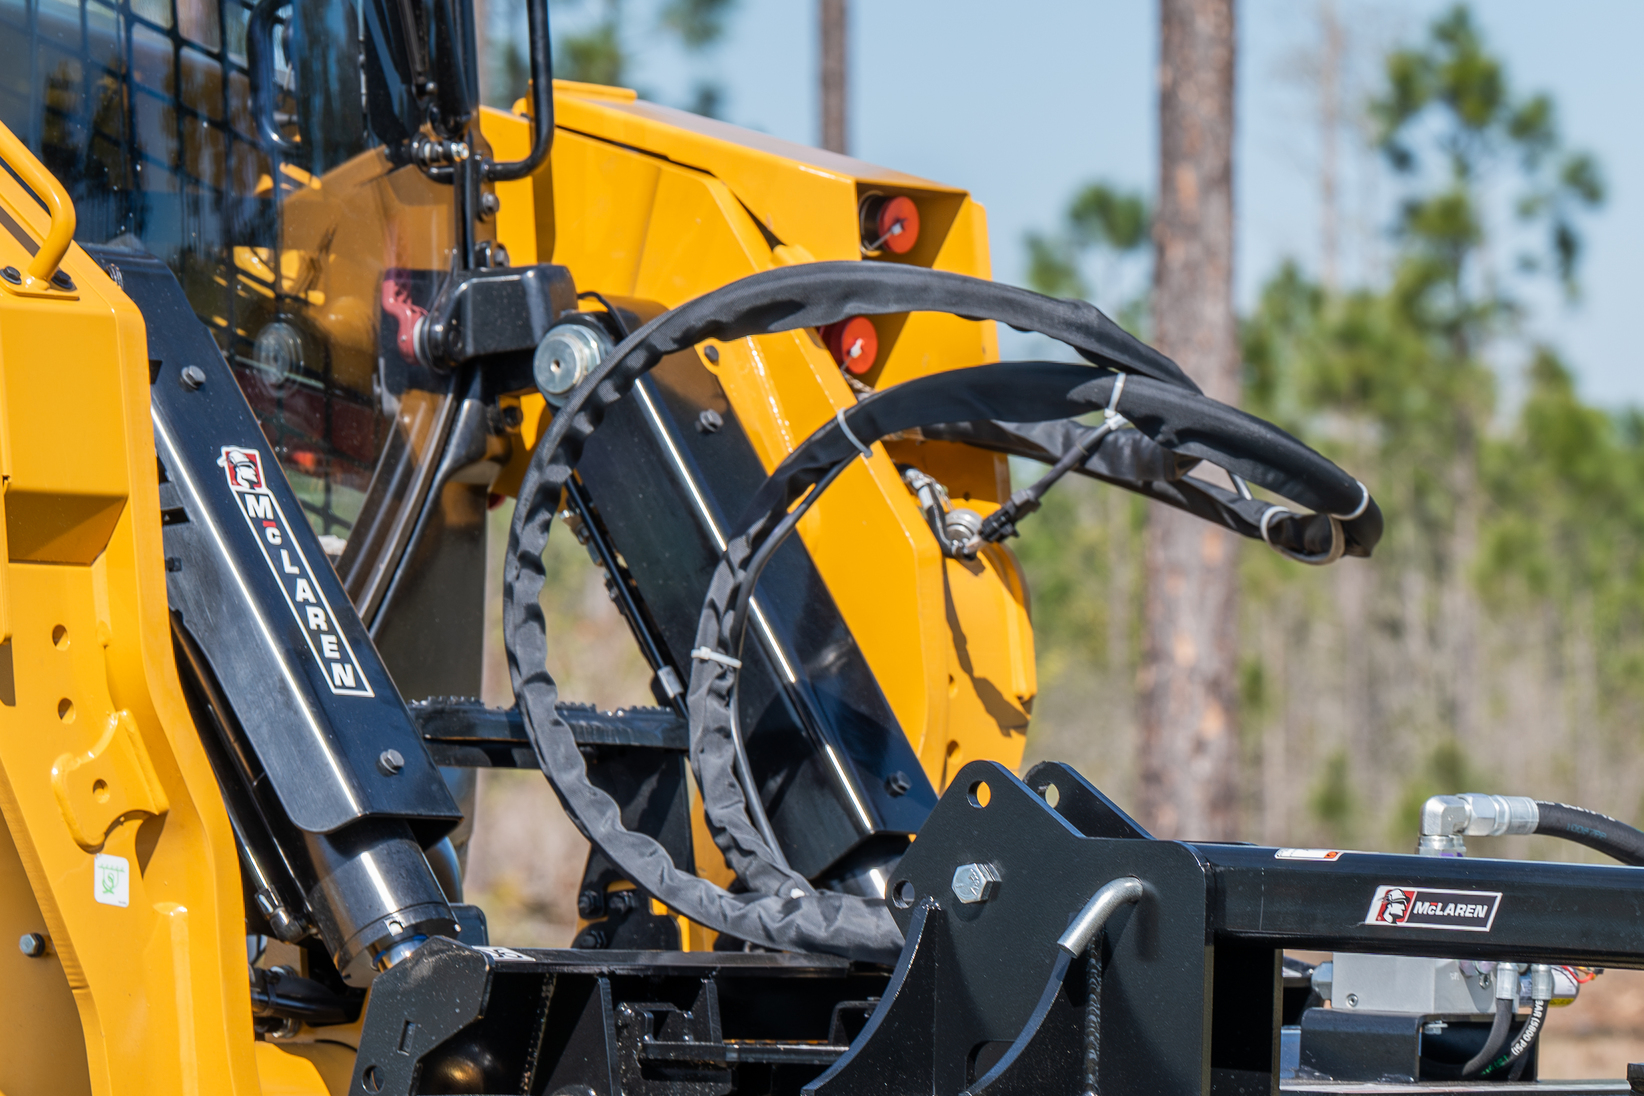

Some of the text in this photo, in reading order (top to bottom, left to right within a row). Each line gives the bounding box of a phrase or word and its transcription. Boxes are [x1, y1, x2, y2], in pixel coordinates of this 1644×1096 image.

[244, 493, 356, 687] McLAREN
[1413, 901, 1488, 918] McLAREN
[1522, 1018, 1540, 1042] (5800
[1511, 1039, 1528, 1056] PSI)
